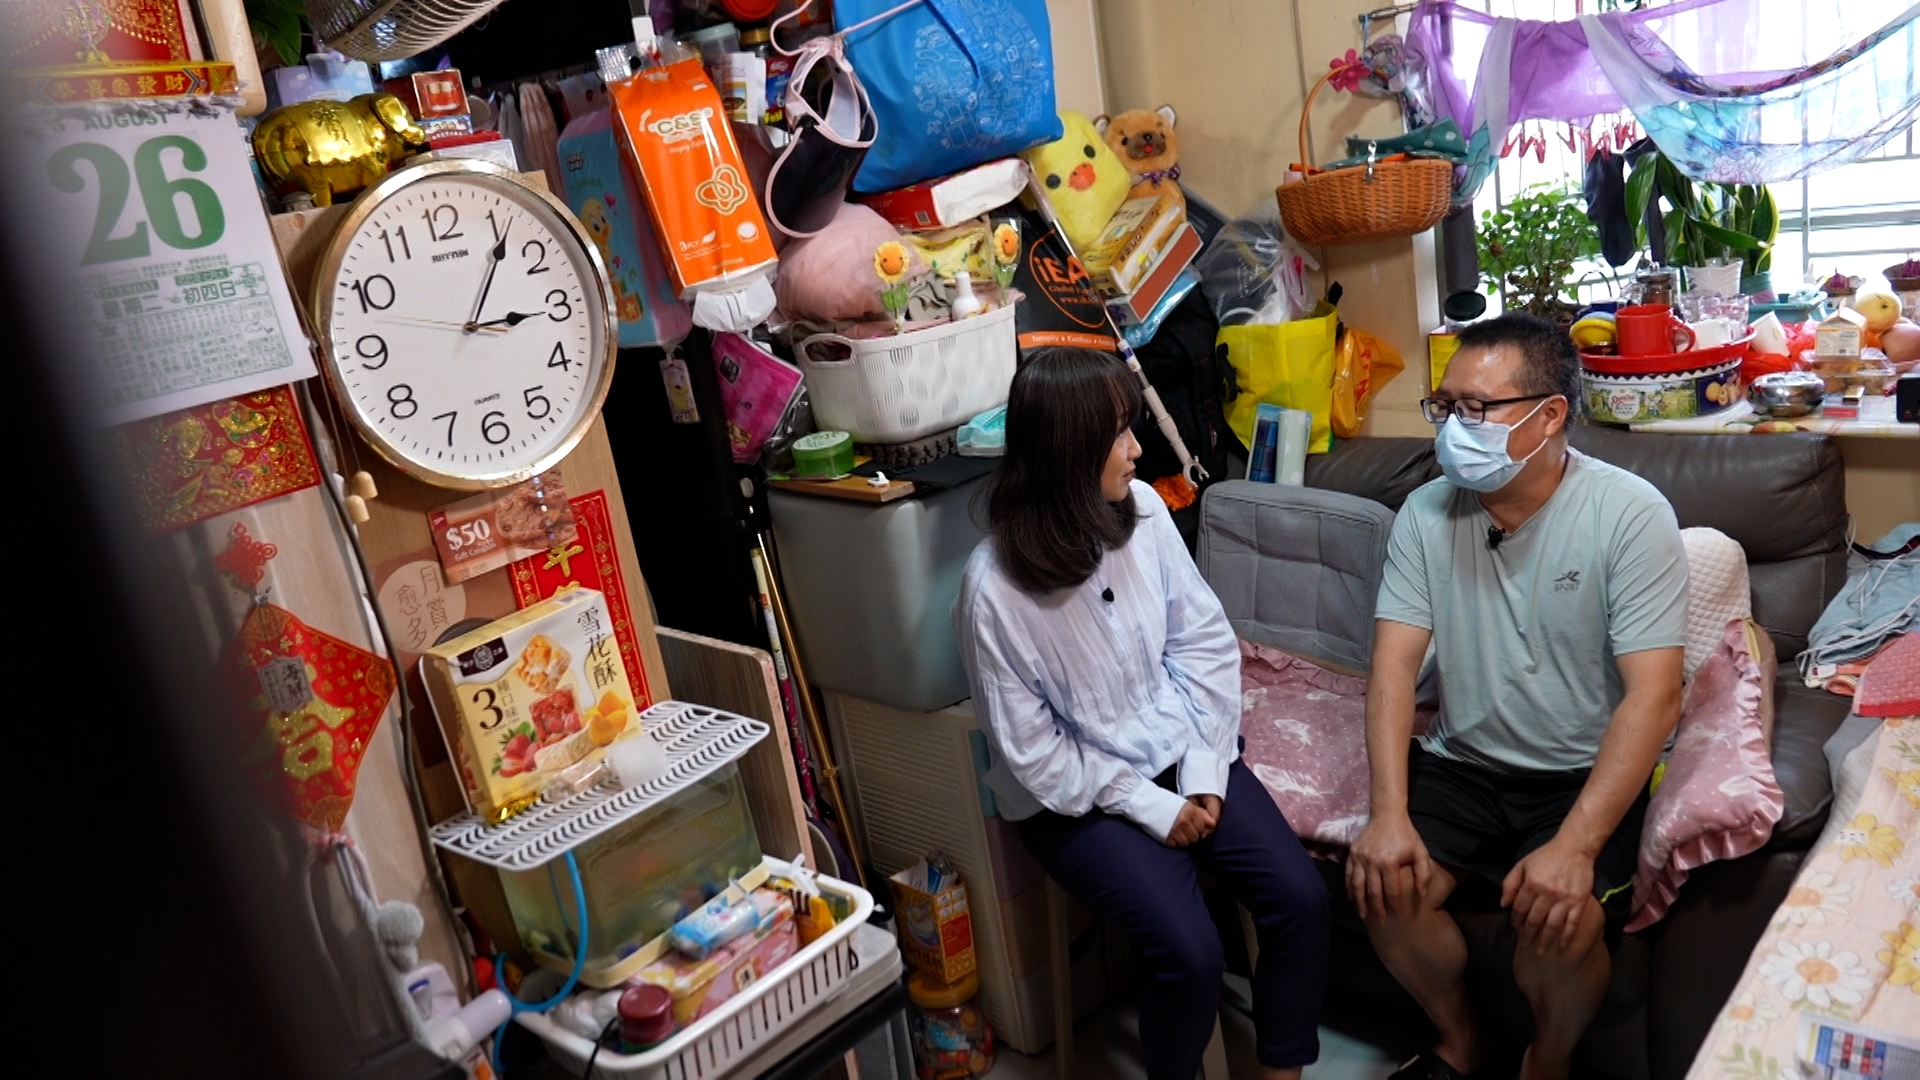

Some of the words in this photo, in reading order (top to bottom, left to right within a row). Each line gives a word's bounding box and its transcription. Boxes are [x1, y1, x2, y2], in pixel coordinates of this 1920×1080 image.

[84, 110, 169, 131] AUGUST
[47, 135, 226, 266] 26
[421, 204, 464, 242] 12
[485, 209, 500, 242] 1
[378, 225, 411, 263] 11
[522, 239, 549, 275] 2
[184, 280, 236, 305] 初四日
[351, 274, 396, 314] 10
[545, 289, 572, 322] 3
[355, 334, 389, 370] 9
[547, 341, 572, 372] 4
[387, 383, 418, 420] 8
[523, 385, 551, 420] 5
[432, 411, 458, 447] 7
[481, 411, 511, 445] 6
[445, 519, 491, 551] $50
[577, 605, 617, 690] 雪花酥
[472, 687, 504, 730] 3
